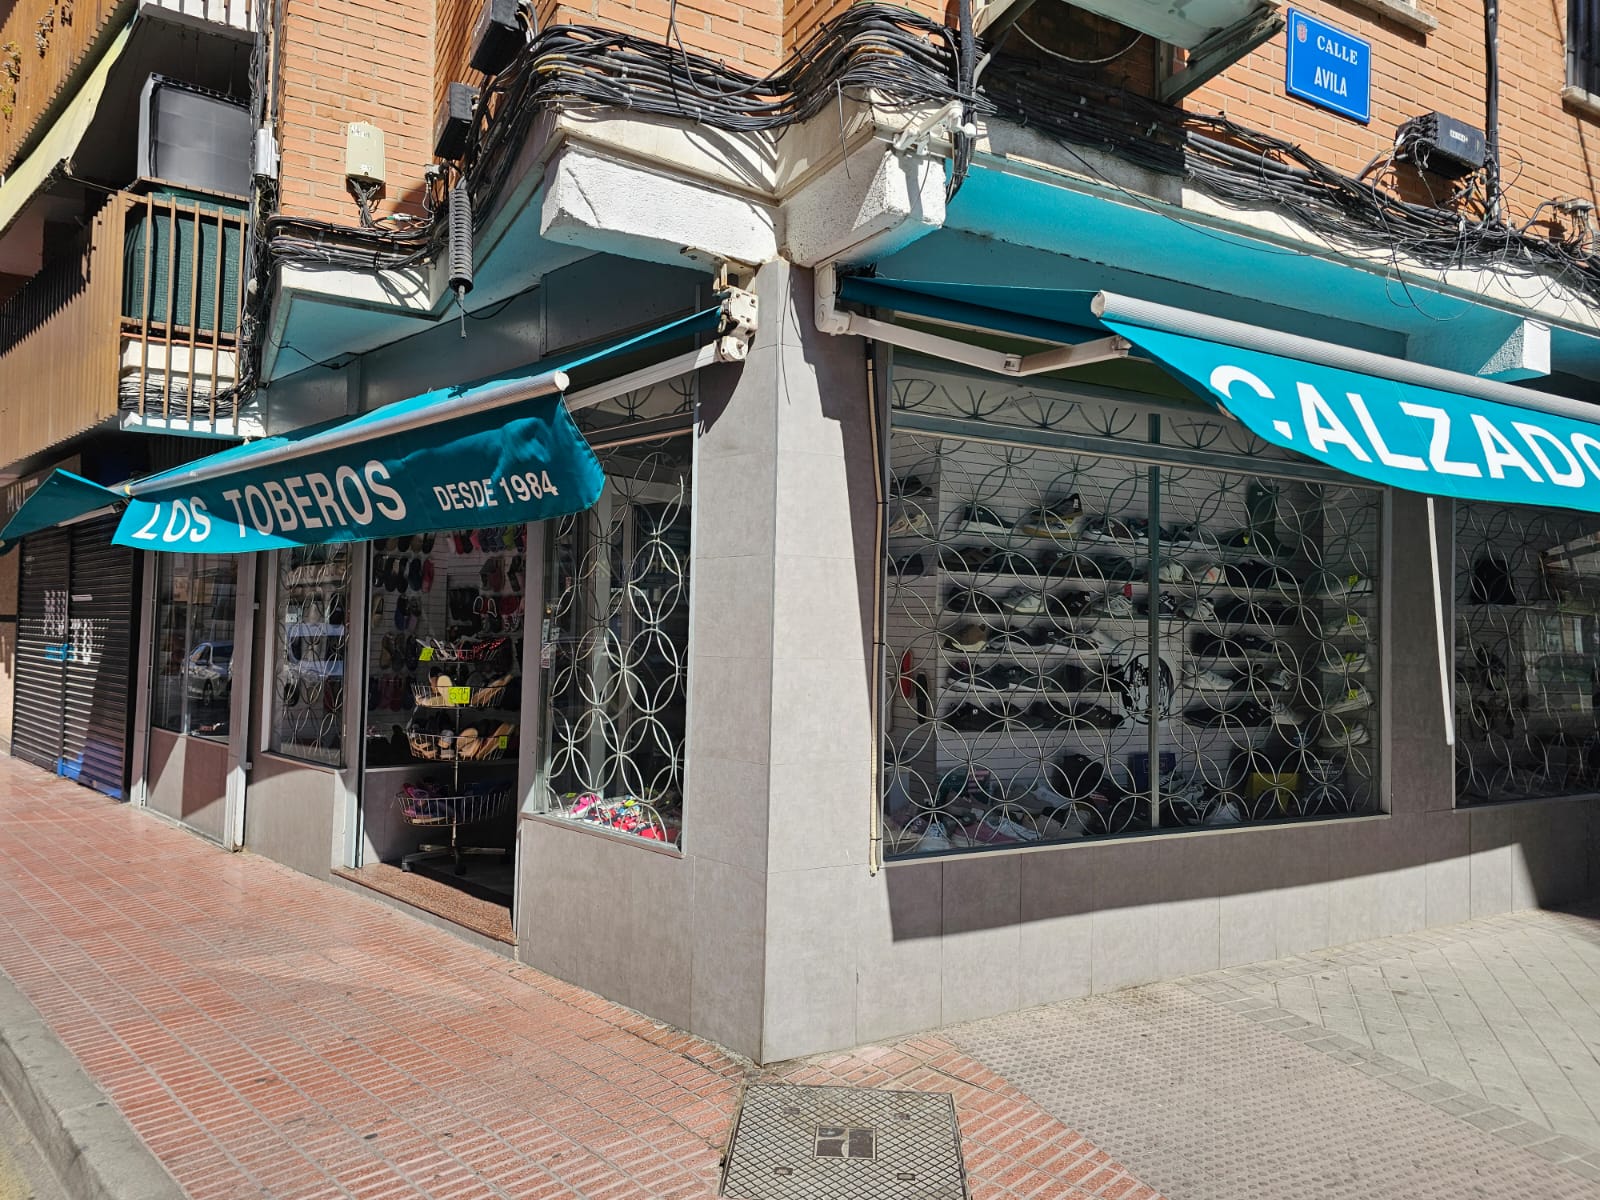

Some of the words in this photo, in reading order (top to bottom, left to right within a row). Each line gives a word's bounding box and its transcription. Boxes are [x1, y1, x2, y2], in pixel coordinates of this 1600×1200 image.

[1316, 35, 1358, 66] CALLE
[1313, 65, 1348, 98] AVILA
[130, 497, 212, 543] LOS
[222, 460, 407, 538] TOBEROS
[433, 478, 499, 512] DESDE
[499, 470, 560, 504] 1984
